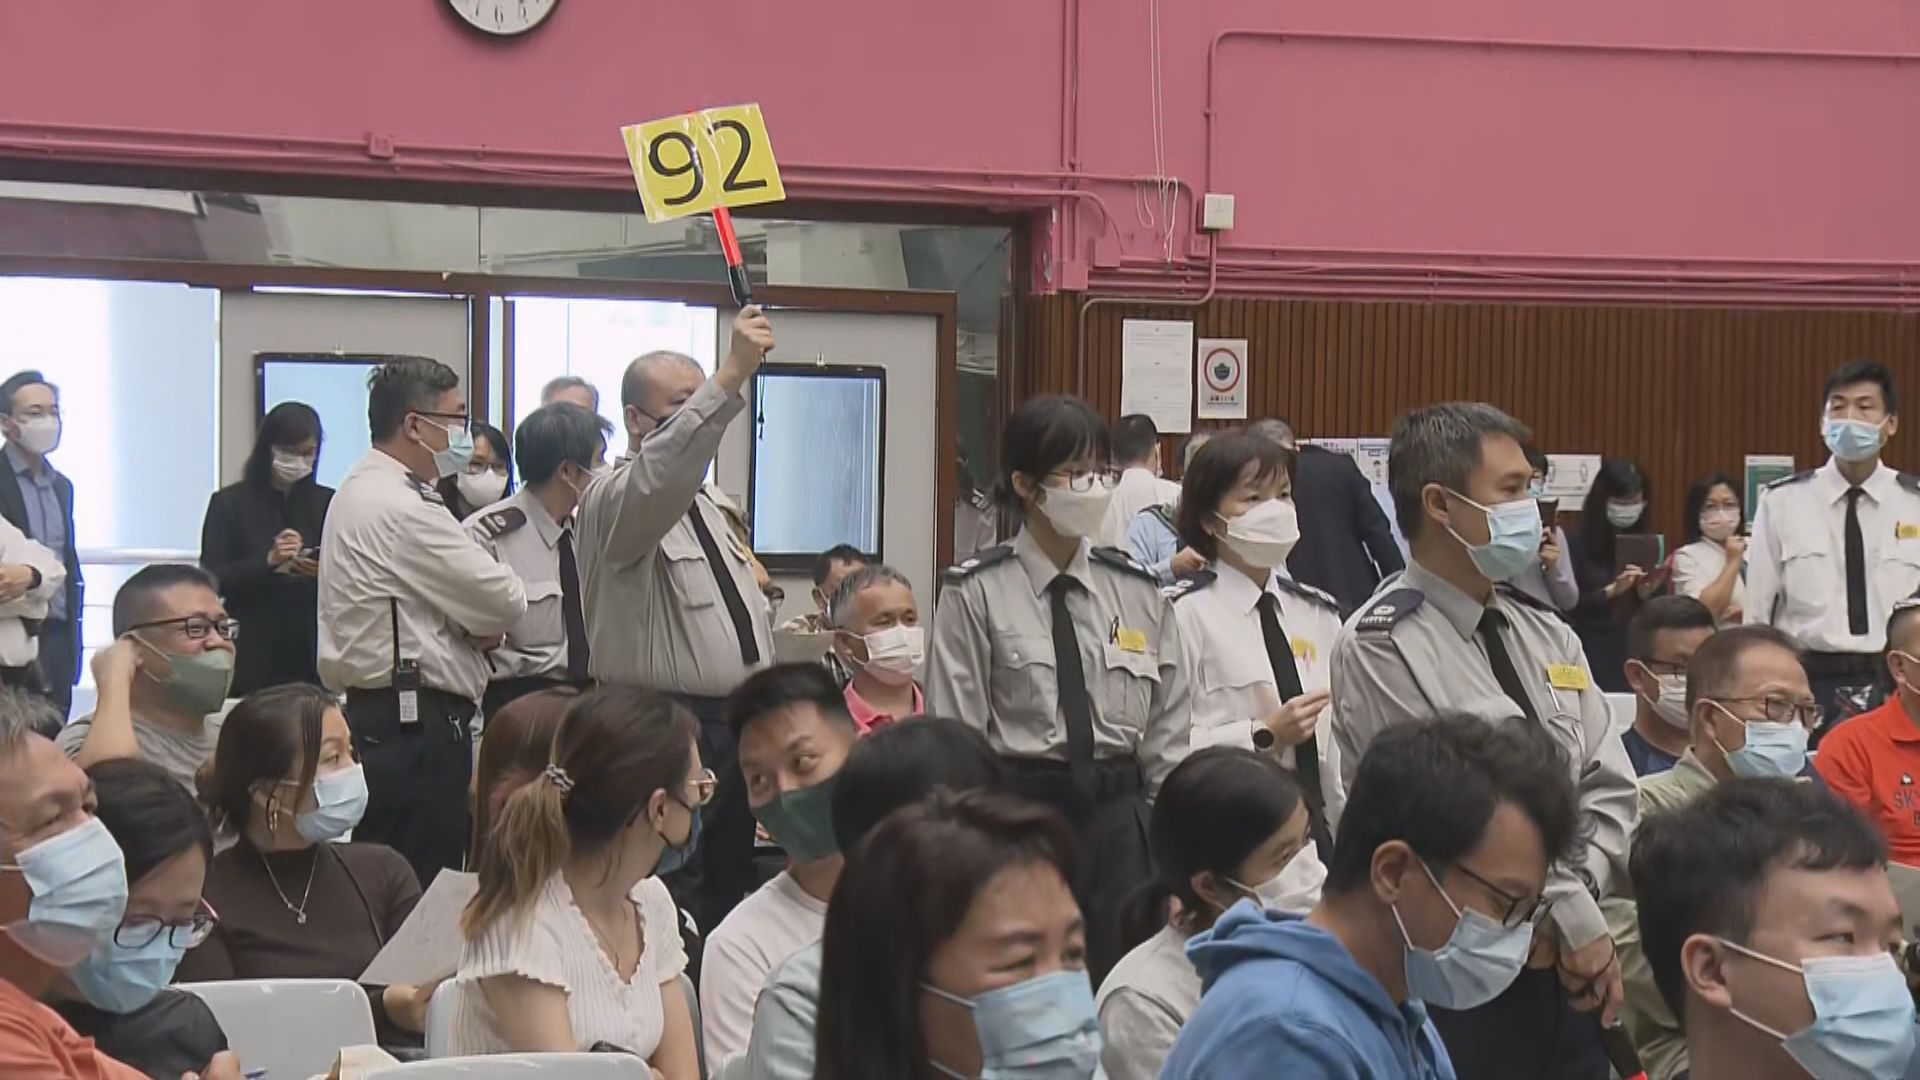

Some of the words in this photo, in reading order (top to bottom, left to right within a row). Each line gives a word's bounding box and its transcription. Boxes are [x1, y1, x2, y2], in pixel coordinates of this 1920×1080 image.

[494, 4, 504, 23] 6
[648, 120, 767, 206] 92
[1892, 789, 1920, 809] SK
